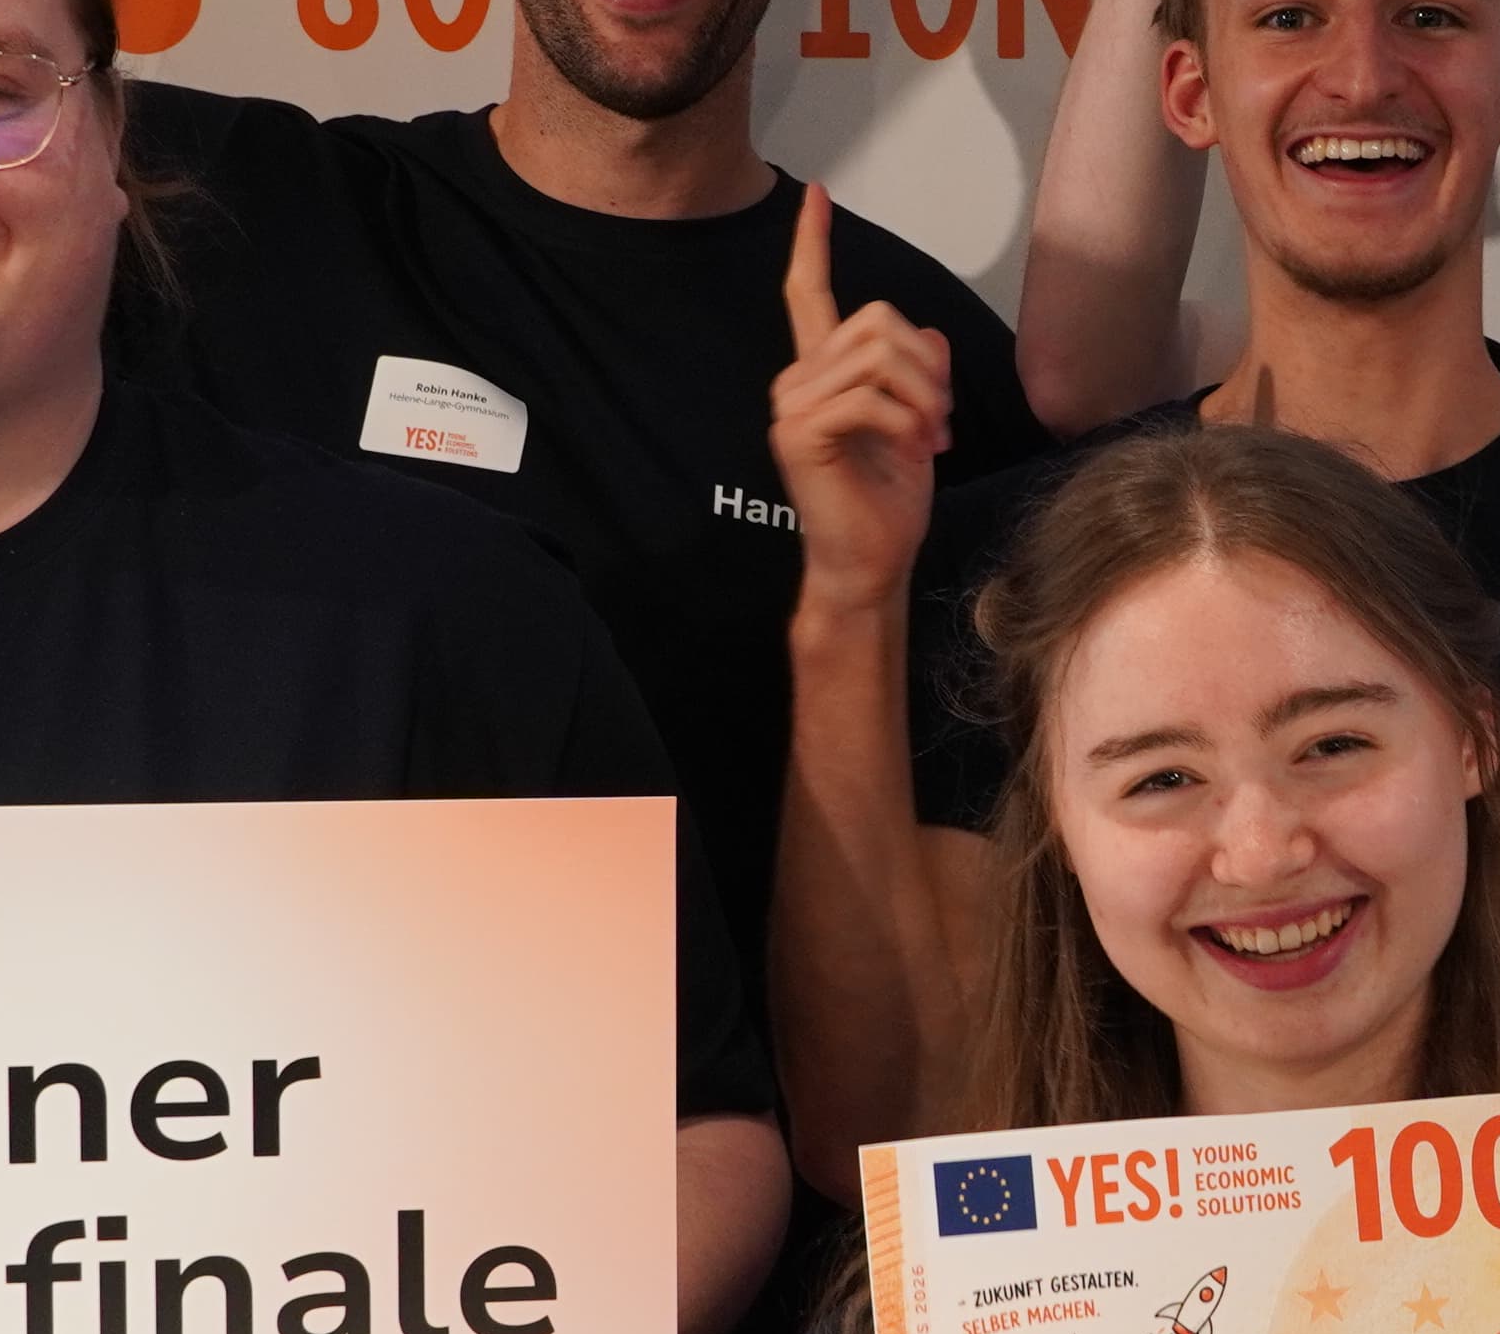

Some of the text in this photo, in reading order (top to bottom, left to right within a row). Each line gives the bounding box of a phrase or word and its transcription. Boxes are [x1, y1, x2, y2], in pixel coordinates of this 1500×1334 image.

[415, 382, 488, 405] Robin Hanke
[405, 426, 445, 453] YES!
[1192, 1143, 1258, 1165] YOUNG
[1047, 1149, 1183, 1227] YES!
[1195, 1165, 1296, 1192] ECONOMIC
[1197, 1190, 1302, 1217] SOLUTIONS
[973, 1270, 1139, 1308] ZUKUNFT GESTALTEN.
[1027, 1299, 1101, 1326] MACHEN.
